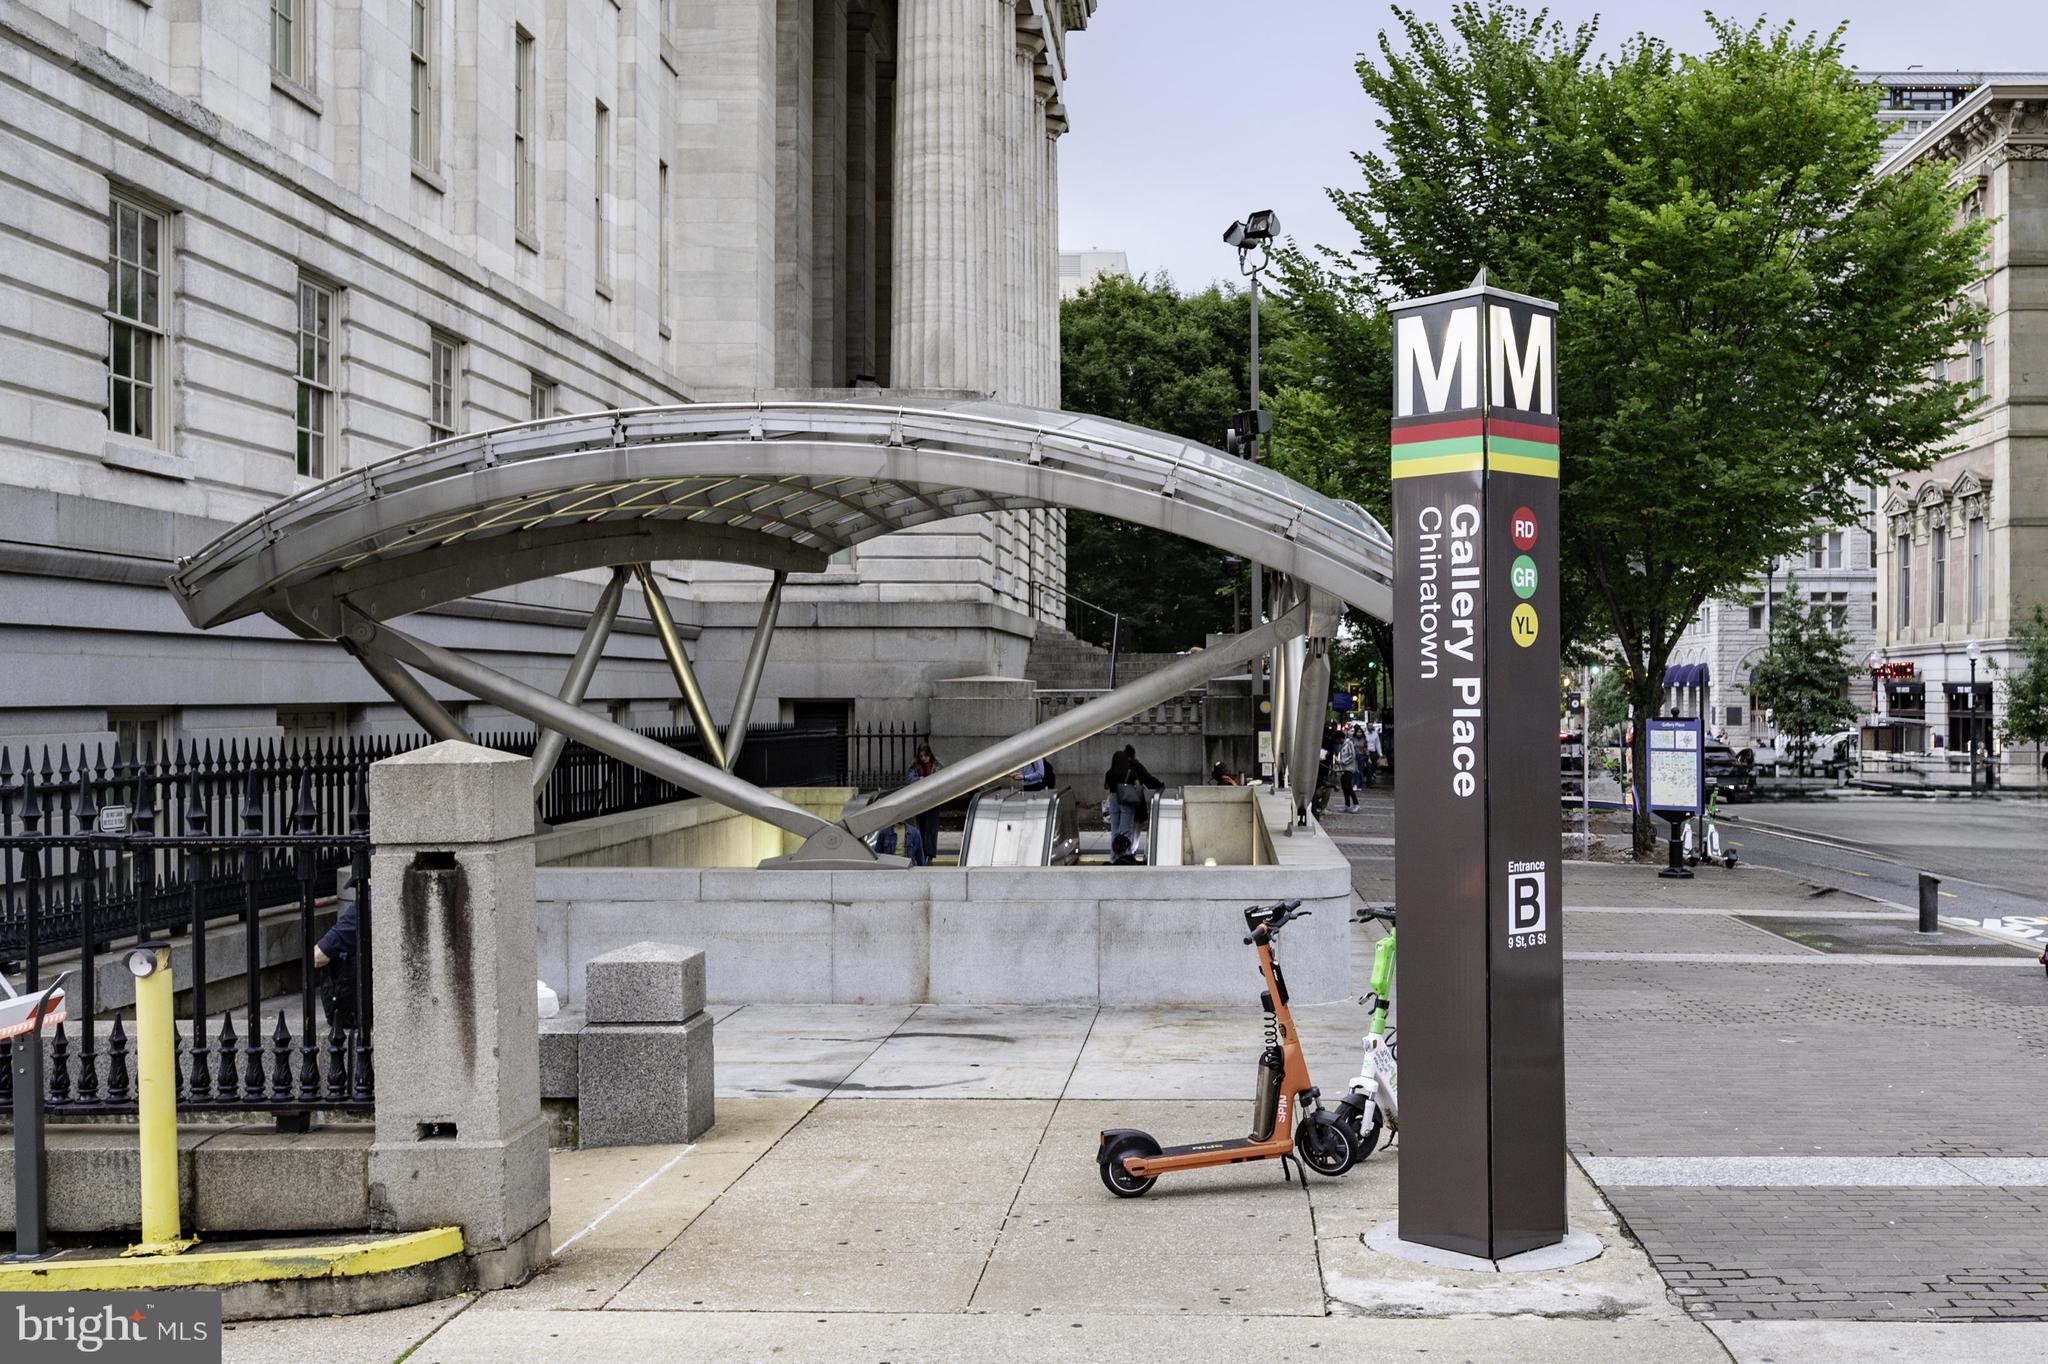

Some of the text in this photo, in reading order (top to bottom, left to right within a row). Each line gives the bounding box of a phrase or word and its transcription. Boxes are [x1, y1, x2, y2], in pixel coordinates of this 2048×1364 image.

[1398, 307, 1477, 416] M
[1490, 304, 1552, 414] M
[1515, 520, 1534, 538] RD
[1419, 506, 1442, 678] Chinatown
[1513, 568, 1535, 588] GR
[1516, 616, 1534, 634] YL
[1444, 504, 1481, 797] Gallery Place
[1508, 861, 1545, 873] Entrance
[1514, 877, 1540, 929] B
[1508, 933, 1547, 948] 9 St, G St
[1278, 1094, 1288, 1124] SPIN
